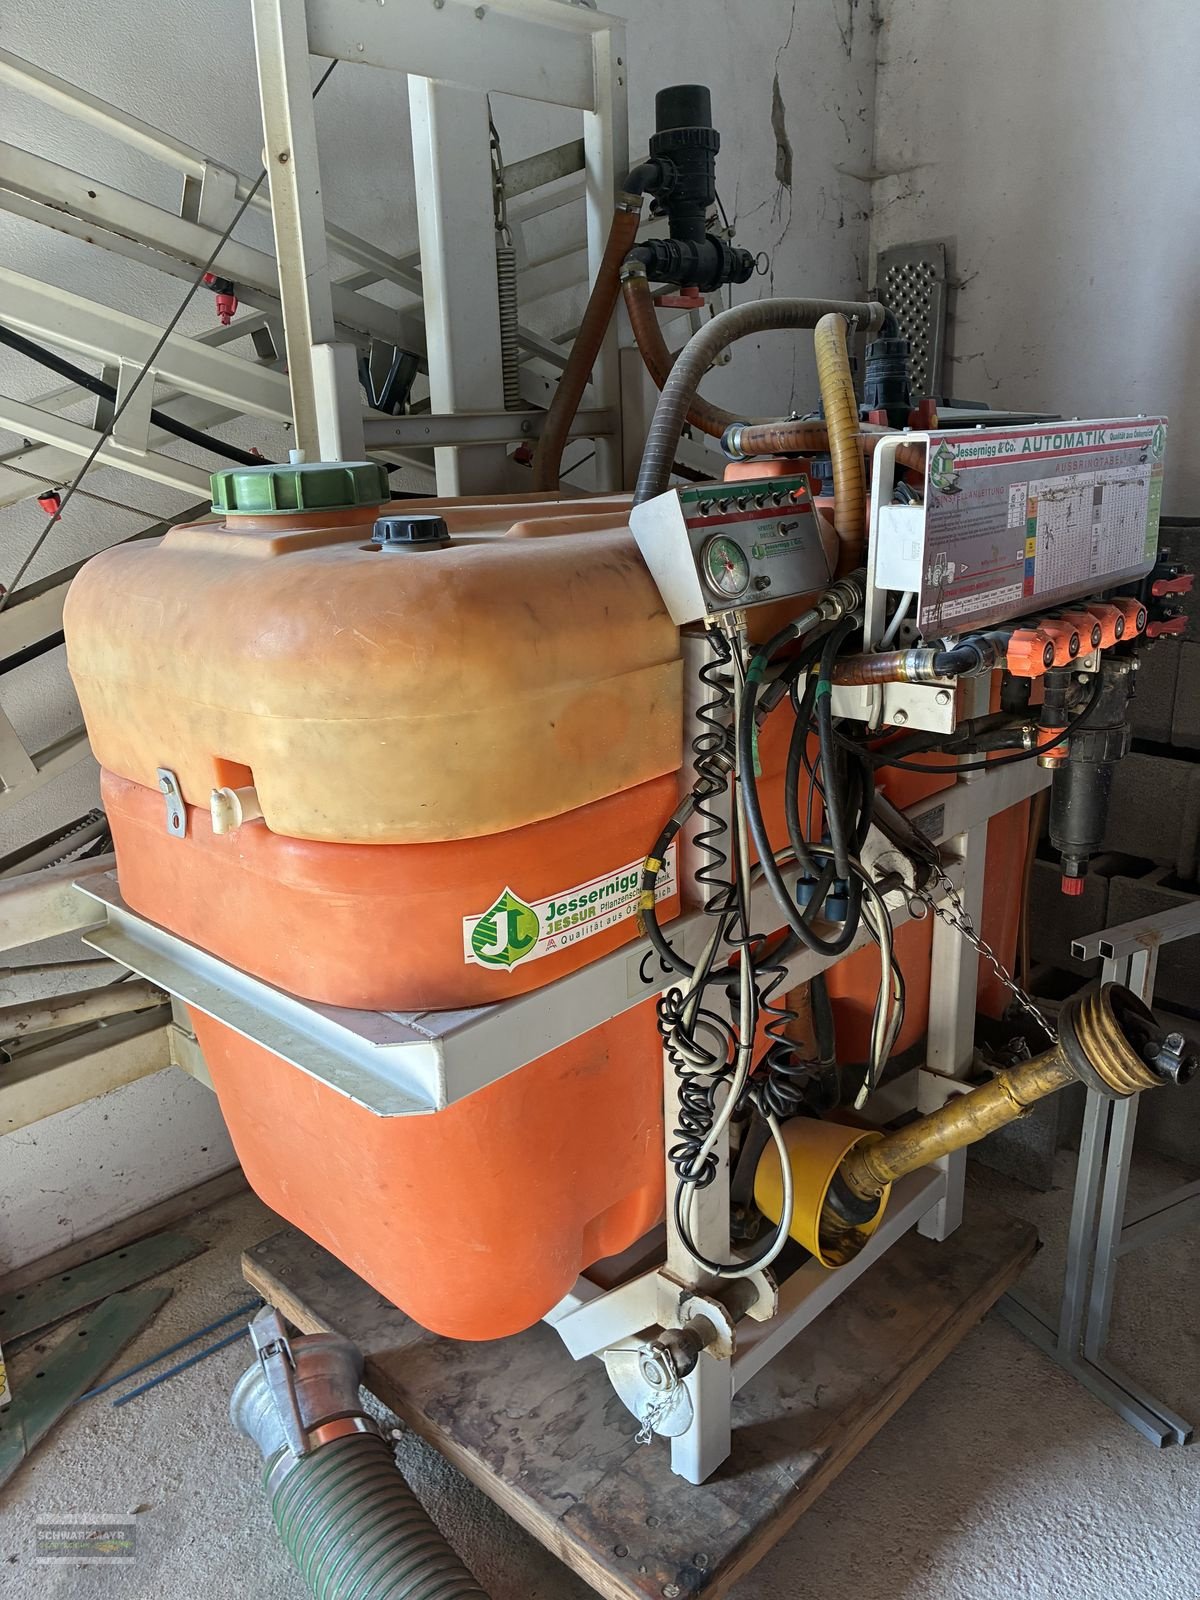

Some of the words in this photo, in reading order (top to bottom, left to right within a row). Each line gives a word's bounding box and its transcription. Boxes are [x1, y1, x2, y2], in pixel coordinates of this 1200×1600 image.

[955, 443, 997, 459] Jessernigg
[998, 441, 1005, 454] &
[1005, 440, 1017, 453] Co.
[1021, 429, 1107, 454] AUTOMATIK
[1109, 429, 1126, 441] Qualität
[1055, 452, 1134, 473] AUSBRINGTABEL
[545, 871, 638, 922] Jessernigg
[546, 906, 596, 936] JESSUR
[560, 918, 603, 945] Qualität
[606, 914, 623, 924] aus
